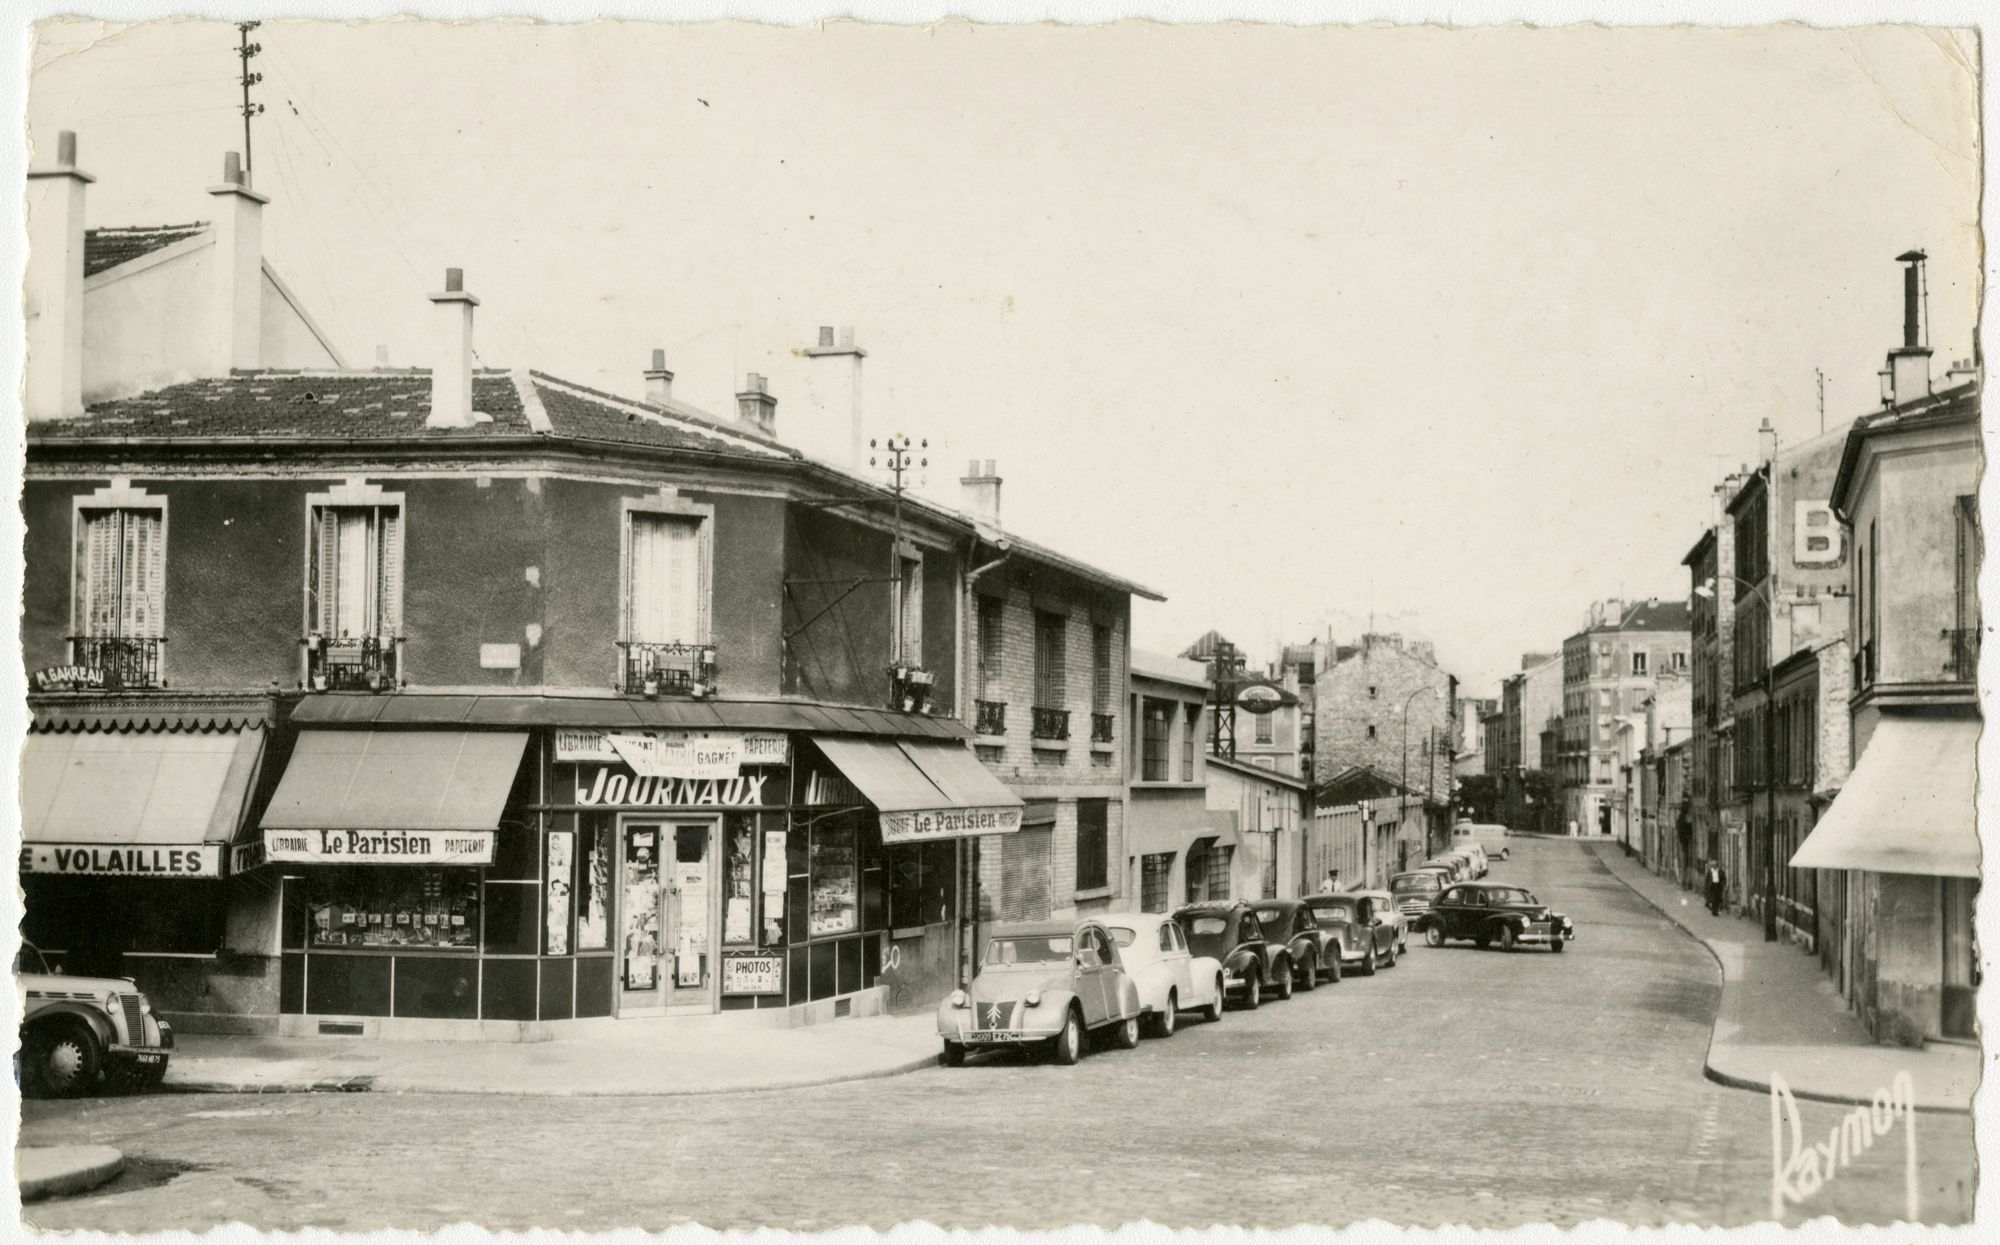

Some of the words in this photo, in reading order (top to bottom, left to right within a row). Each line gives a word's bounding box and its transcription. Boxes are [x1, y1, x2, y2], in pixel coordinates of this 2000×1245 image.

[559, 734, 602, 752] LIBRAIRIE
[744, 738, 785, 755] PAPETERIE
[577, 767, 768, 806] JOURNAUX
[914, 812, 932, 833] Le
[935, 808, 996, 832] Parisien
[271, 836, 308, 853] LIBRAIRIE
[320, 830, 343, 854] Le
[347, 830, 431, 855] Parisien
[445, 838, 485, 853] PAPETERIE
[54, 848, 202, 872] VOLAILLES
[735, 961, 771, 974] PHOTOS
